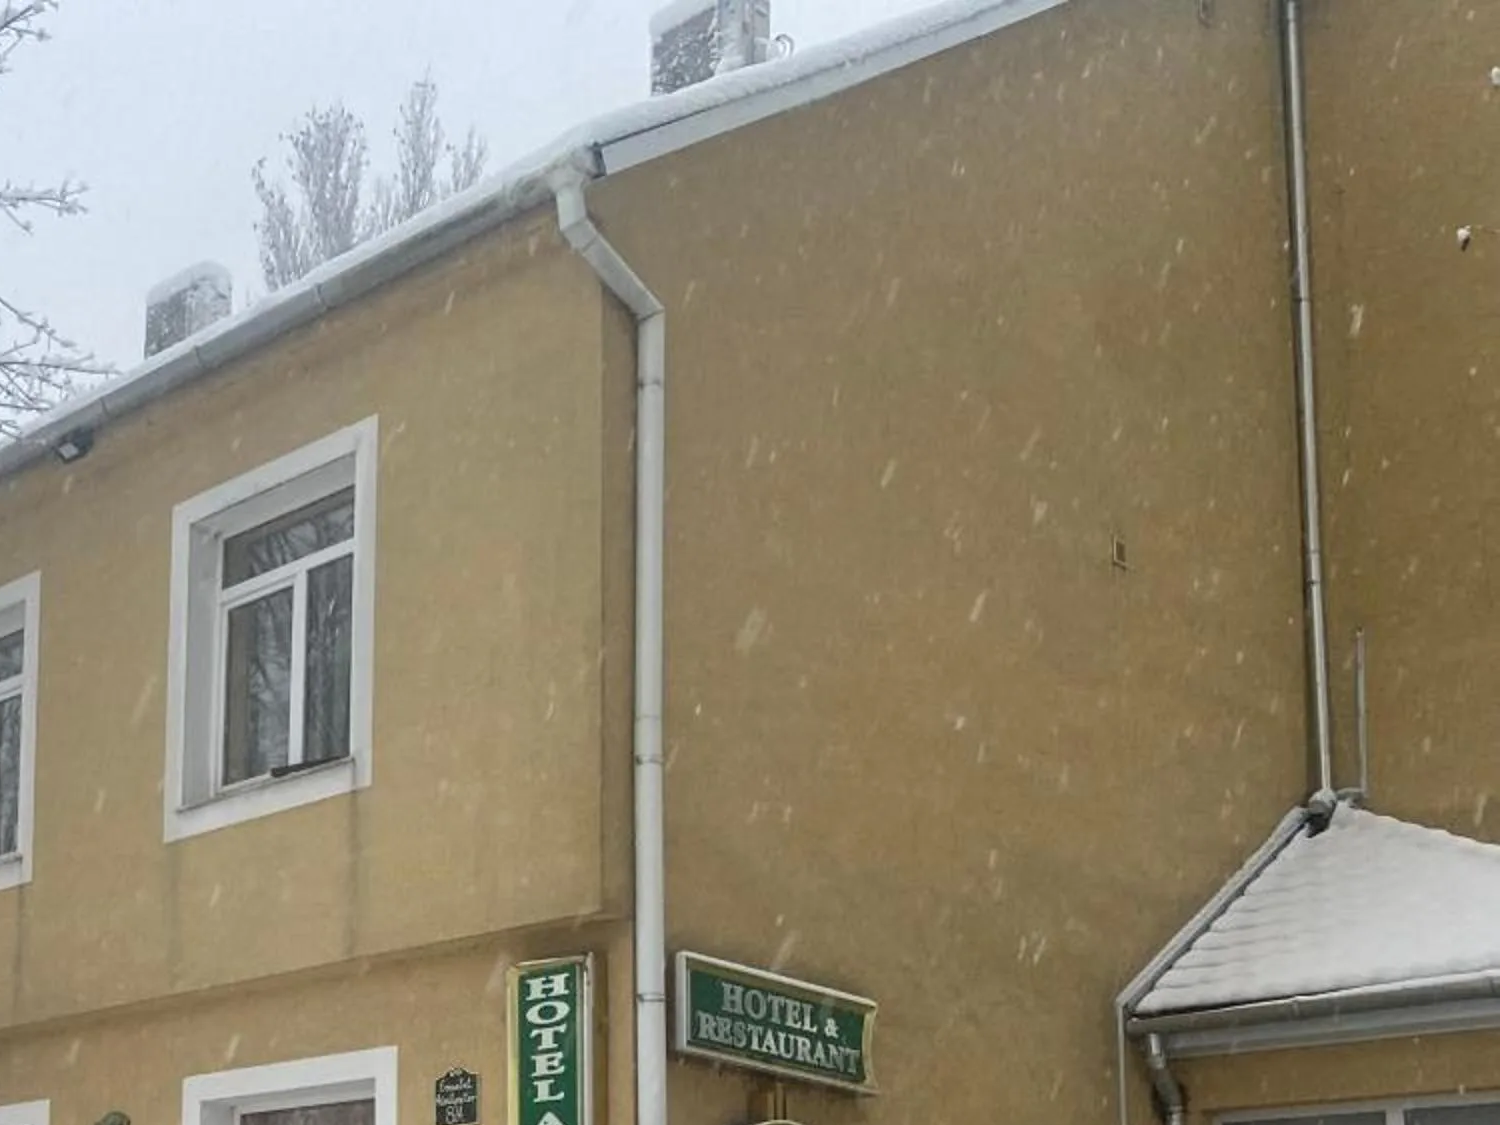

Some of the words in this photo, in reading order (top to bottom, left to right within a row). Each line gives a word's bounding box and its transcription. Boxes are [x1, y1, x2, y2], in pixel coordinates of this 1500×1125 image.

[525, 973, 571, 1103] HOTEL
[721, 981, 818, 1034] HOTEL
[823, 1017, 839, 1039] &
[697, 1011, 861, 1075] RESTAURANT
